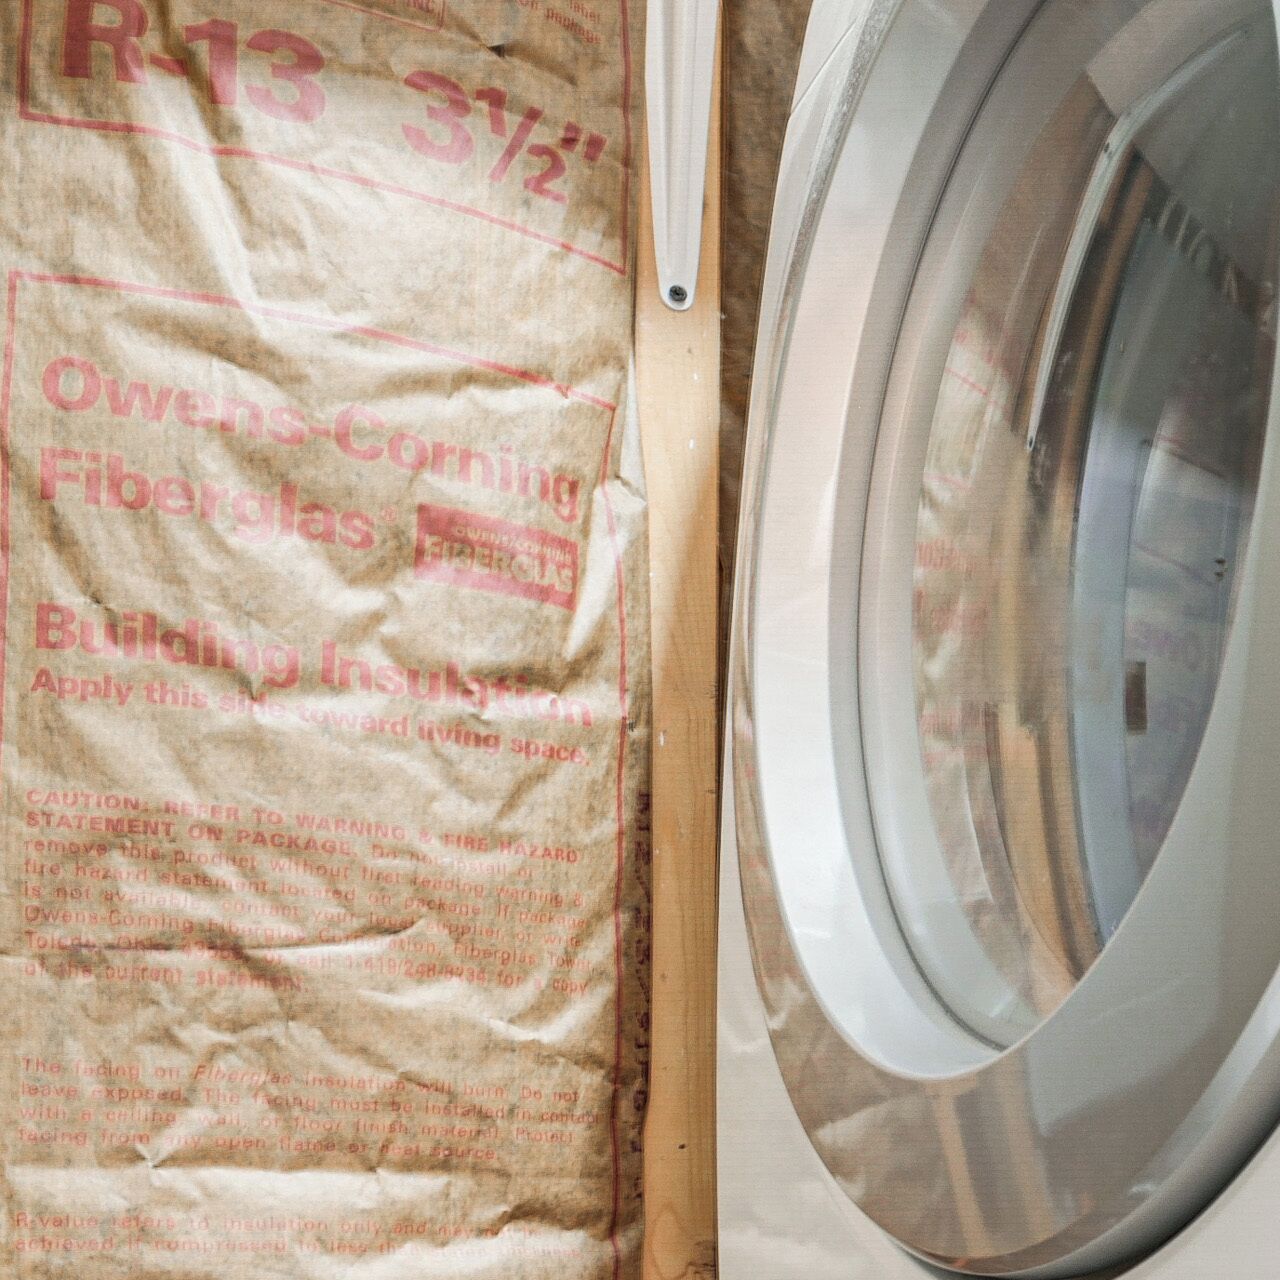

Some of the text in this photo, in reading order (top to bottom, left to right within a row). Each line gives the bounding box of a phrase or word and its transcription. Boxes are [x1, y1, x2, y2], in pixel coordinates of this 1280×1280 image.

[59, 0, 328, 123] R-13
[41, 355, 581, 522] Owens-Corning
[424, 534, 573, 593] FIBERGLAS
[34, 601, 594, 728] Building Insulation
[30, 667, 134, 706] Apply
[143, 680, 210, 711] this
[219, 690, 287, 723] side
[298, 705, 410, 740] toward
[418, 718, 501, 754] living
[25, 811, 176, 837] STATEMENT
[188, 822, 224, 841] ON
[164, 800, 240, 822] REFER
[253, 807, 284, 825] TO
[296, 813, 406, 841] WARNING
[444, 832, 490, 852] FIRE
[500, 839, 579, 864] HAZARD
[23, 1058, 61, 1074] The
[154, 1066, 180, 1080] on
[193, 1064, 291, 1086] Fiberglas
